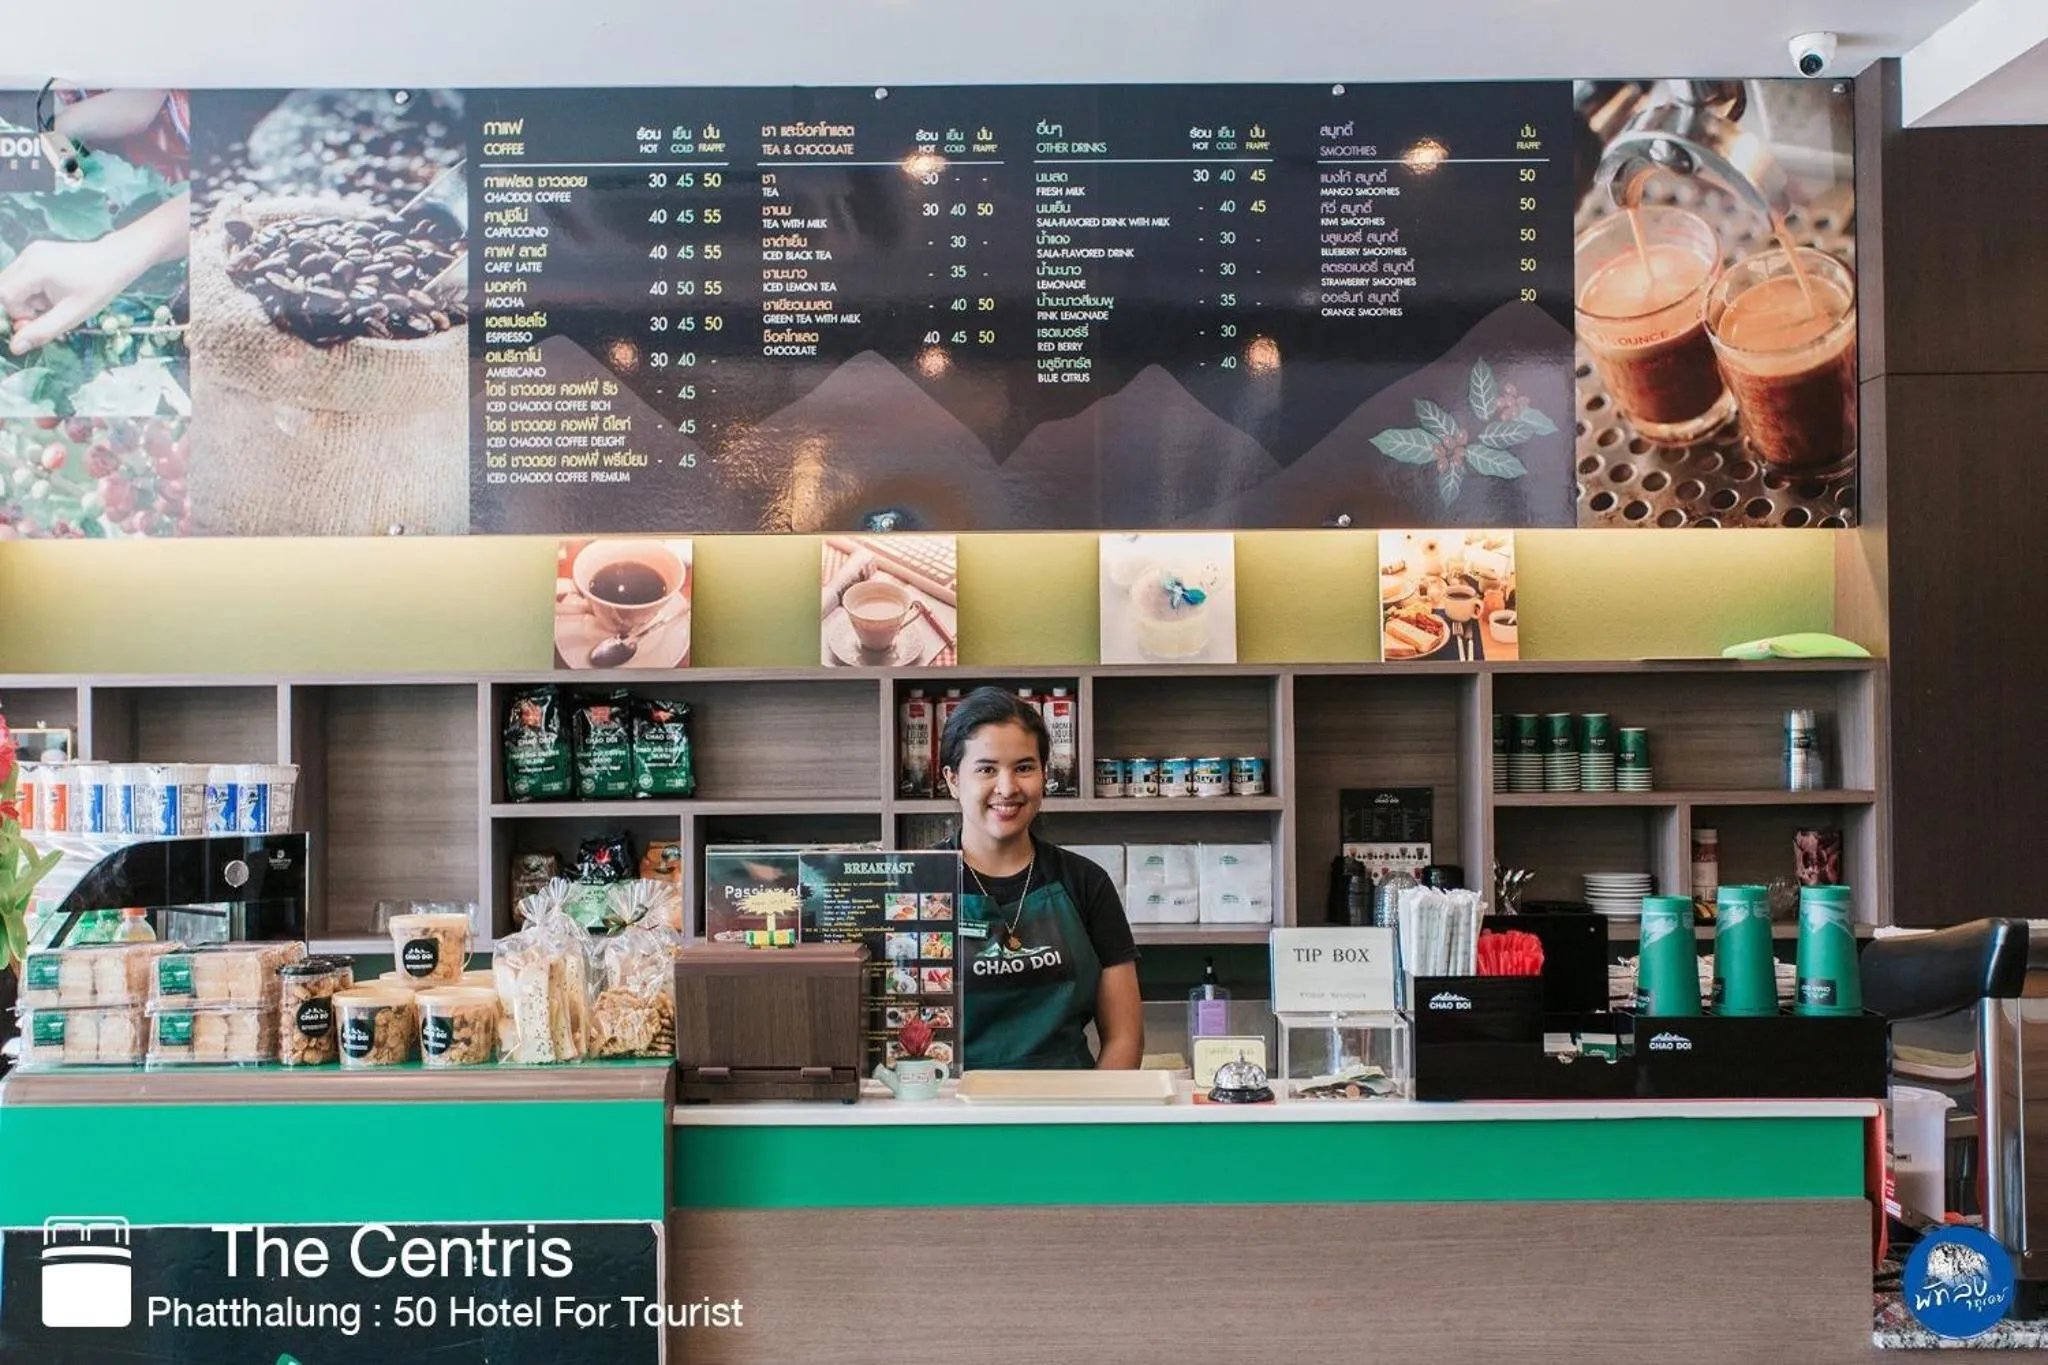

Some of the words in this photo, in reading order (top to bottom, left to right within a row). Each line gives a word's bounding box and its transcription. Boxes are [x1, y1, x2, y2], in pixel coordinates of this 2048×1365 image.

[483, 118, 524, 136] กาแฟ
[762, 126, 777, 137] ชา
[636, 126, 662, 140] ร้อน
[672, 126, 692, 139] เย็น
[484, 143, 524, 156] COFFEE
[640, 144, 658, 153] HOT
[670, 144, 694, 153] COLD
[762, 145, 781, 155] TEA
[784, 145, 792, 155] &
[794, 144, 854, 155] CHOCOLATE
[919, 145, 935, 153] HOT
[944, 144, 965, 152] COLD
[1037, 143, 1069, 153] OTHER
[1072, 143, 1107, 152] DRINKS
[1193, 141, 1209, 150] HOT
[1217, 141, 1237, 150] COLD
[1320, 146, 1377, 156] SMOOTHIES
[648, 173, 667, 188] 30
[676, 173, 694, 188] 45
[704, 173, 721, 187] 50
[762, 174, 776, 185] ชา
[1036, 172, 1068, 182] นมสด
[1193, 169, 1210, 182] 30
[1220, 169, 1235, 182] 40
[1250, 169, 1266, 182] 45
[1520, 169, 1535, 181] 50
[535, 191, 571, 203] COFFEE
[762, 187, 779, 197] TEA
[1036, 187, 1063, 196] FRESH
[1065, 187, 1085, 196] MILK
[1321, 188, 1353, 196] MANGO
[1355, 187, 1400, 196] SMOOTHIES
[1036, 202, 1071, 214] นมเย็น
[1220, 200, 1236, 213] 40
[1250, 200, 1266, 212] 45
[1520, 198, 1535, 210] 50
[762, 205, 791, 216] ชานม
[922, 204, 939, 217] 30
[950, 204, 966, 216] 40
[977, 203, 993, 216] 50
[648, 209, 667, 224] 40
[677, 209, 694, 223] 45
[704, 209, 721, 223] 55
[1102, 218, 1127, 227] DRINK
[1129, 217, 1150, 227] WITH
[1151, 217, 1171, 227] MILK
[1321, 217, 1338, 226] KIWI
[1341, 217, 1385, 226] SMOOTHIES
[762, 219, 780, 228] TEA
[782, 219, 804, 228] WITH
[807, 219, 827, 228] MILK
[485, 227, 549, 238] CAPPUCCINO
[1220, 232, 1236, 244] 30
[1520, 228, 1536, 240] 50
[950, 236, 966, 248] 30
[649, 245, 667, 259] 40
[677, 245, 694, 259] 45
[704, 245, 722, 259] 55
[763, 251, 783, 260] ICED
[785, 251, 815, 260] BLACK
[816, 251, 832, 260] TEA
[1108, 249, 1134, 258] DRINK
[1321, 247, 1360, 256] BLUEBERRY
[1363, 247, 1407, 256] SMOOTHIES
[516, 262, 542, 272] LATTE
[1220, 263, 1236, 275] 30
[1521, 258, 1536, 271] 50
[763, 269, 807, 280] ชามะนาว
[950, 266, 966, 278] 35
[763, 283, 783, 292] ICED
[785, 283, 818, 292] LEMON
[820, 283, 837, 292] TEA
[1037, 280, 1086, 289] LEMONADE
[1322, 278, 1369, 286] STRAWBERRY
[1372, 278, 1416, 286] SMOOTHIES
[649, 281, 668, 295] 40
[677, 281, 694, 295] 50
[704, 281, 722, 295] 55
[1521, 289, 1536, 300] 50
[485, 297, 524, 308] MOCHA
[951, 299, 967, 311] 40
[978, 298, 994, 310] 50
[1220, 294, 1236, 307] 35
[1037, 311, 1059, 320] PINK
[1060, 311, 1109, 320] LEMONADE
[1322, 308, 1355, 317] ORANGE
[1358, 307, 1402, 317] SMOOTHIES
[650, 317, 668, 331] 30
[677, 317, 695, 331] 45
[704, 316, 722, 331] 50
[763, 314, 794, 324] GREEN
[796, 314, 812, 324] TEA
[816, 314, 837, 323] WITH
[840, 314, 860, 324] MILK
[1221, 325, 1236, 337] 30
[486, 332, 533, 343] ESPRESSO
[924, 331, 940, 344] 40
[951, 331, 967, 343] 45
[979, 331, 994, 343] 50
[1617, 331, 1668, 346] OUNCE
[763, 346, 817, 356] CHOCOLATE
[1037, 342, 1056, 351] RED
[1058, 342, 1083, 351] BERRY
[650, 353, 668, 367] 30
[678, 352, 695, 367] 40
[1220, 356, 1236, 368] 40
[486, 367, 546, 378] AMERICANO
[1038, 373, 1058, 383] BLUE
[1061, 373, 1090, 383] CITRUS
[678, 385, 695, 399] 45
[486, 401, 506, 412] ICED
[555, 401, 587, 411] COFFEE
[591, 401, 610, 411] RICH
[678, 420, 695, 435] 45
[487, 437, 506, 447] ICED
[556, 436, 588, 447] COFFEE
[591, 436, 625, 447] DELIGHT
[679, 455, 696, 469] 45
[487, 473, 506, 483] ICED
[556, 472, 589, 482] COFFEE
[591, 472, 629, 482] PREMIUM
[844, 862, 915, 875] BREAKFAST
[1293, 948, 1322, 963] TIP
[1333, 948, 1370, 963] BOX
[973, 959, 1025, 976] CHAO
[1030, 951, 1062, 969] DOI
[1429, 1001, 1454, 1010] CHAO
[1456, 1001, 1472, 1010] DOI
[1649, 1041, 1674, 1050] CHAO
[1676, 1041, 1692, 1050] DOI
